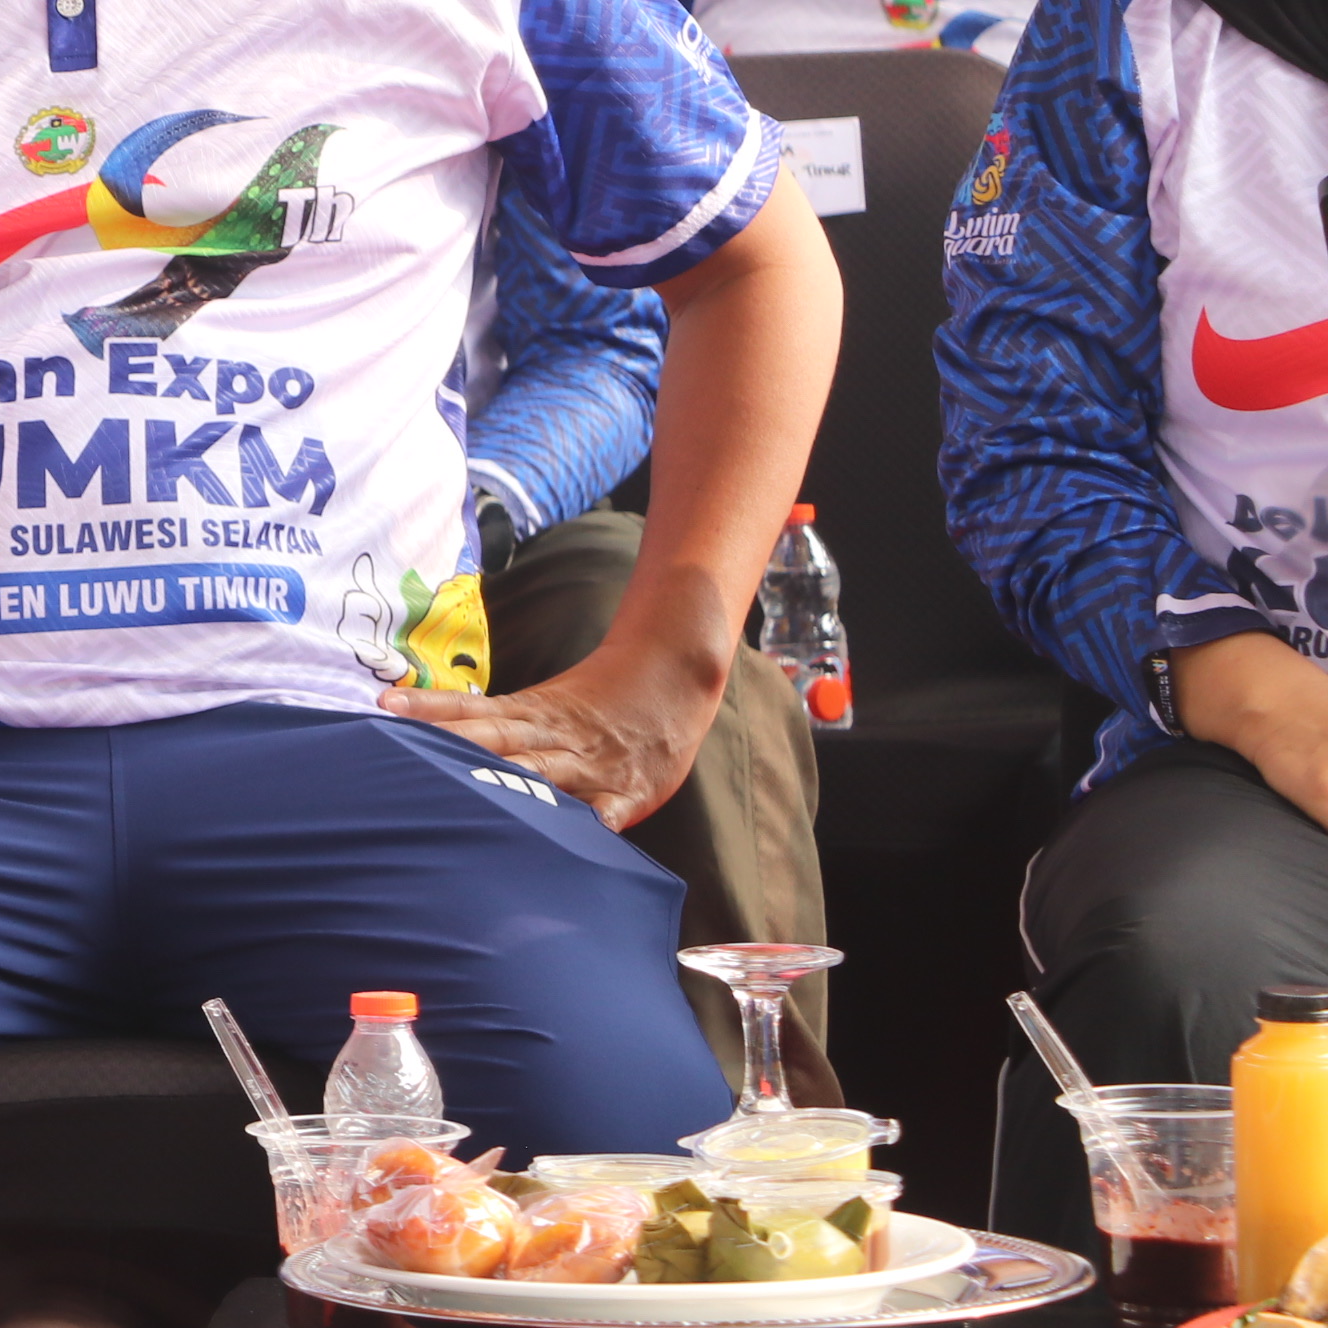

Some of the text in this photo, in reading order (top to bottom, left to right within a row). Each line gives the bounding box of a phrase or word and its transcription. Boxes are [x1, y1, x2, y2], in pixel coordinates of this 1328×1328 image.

[944, 207, 1021, 240] Lutim
[107, 341, 315, 415] Expo
[10, 517, 189, 557] SULAWESI
[201, 518, 324, 557] SELATAN
[59, 579, 166, 618] LUWU
[179, 576, 289, 612] TIMUR
